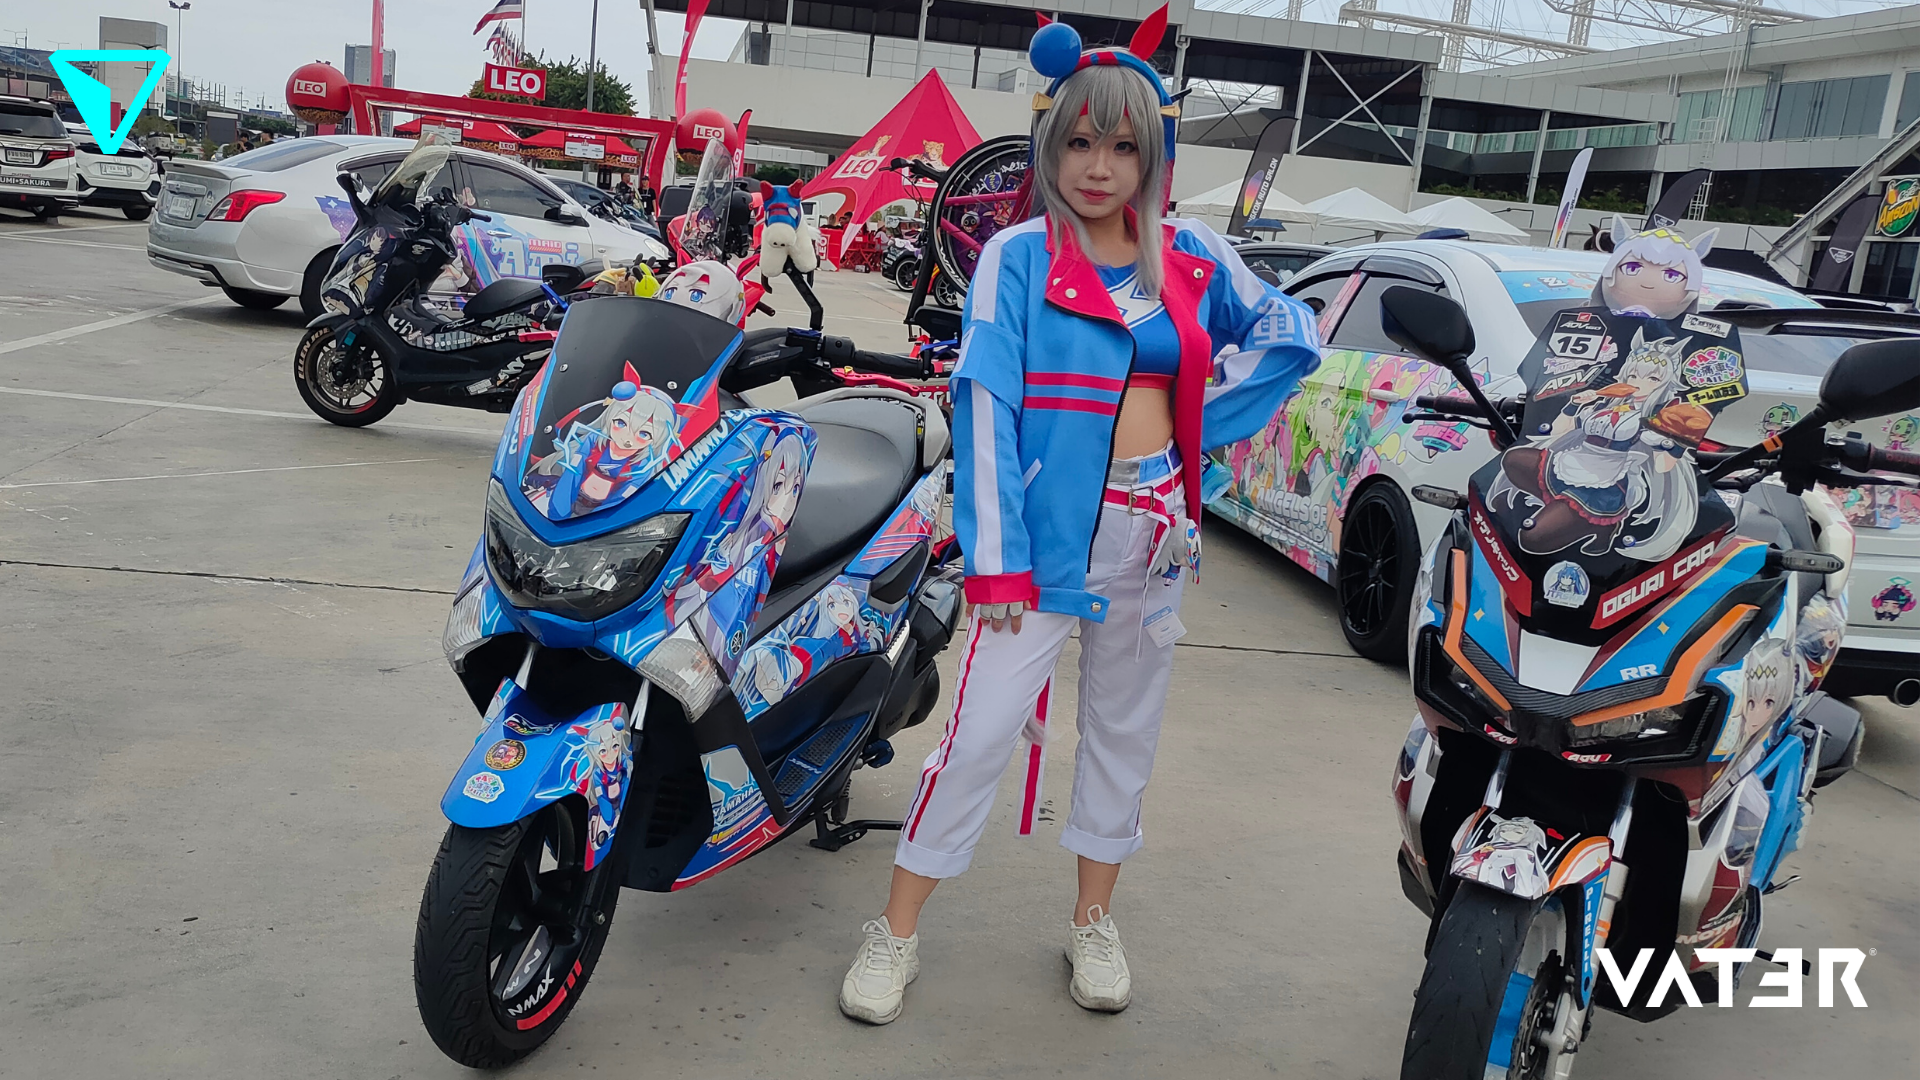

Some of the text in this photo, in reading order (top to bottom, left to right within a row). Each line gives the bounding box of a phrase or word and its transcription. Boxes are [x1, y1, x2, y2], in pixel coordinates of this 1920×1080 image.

[296, 81, 324, 94] LEO
[490, 68, 541, 94] LEO
[697, 127, 722, 139] LEO
[841, 159, 878, 175] LEO
[1257, 181, 1270, 203] AUTO
[1264, 158, 1279, 183] SALON
[529, 240, 561, 249] MAID
[819, 236, 828, 260] LEO
[1557, 335, 1592, 355] 15
[1684, 350, 1737, 374] ITASHA
[1536, 363, 1606, 396] ADV
[1256, 486, 1328, 527] ANGELS OF
[1602, 540, 1715, 619] OGURI CAP
[1619, 663, 1659, 681] RR
[713, 786, 755, 818] YAMAHA
[1584, 887, 1594, 973] PIRELLI
[507, 962, 556, 1016] NMAX
